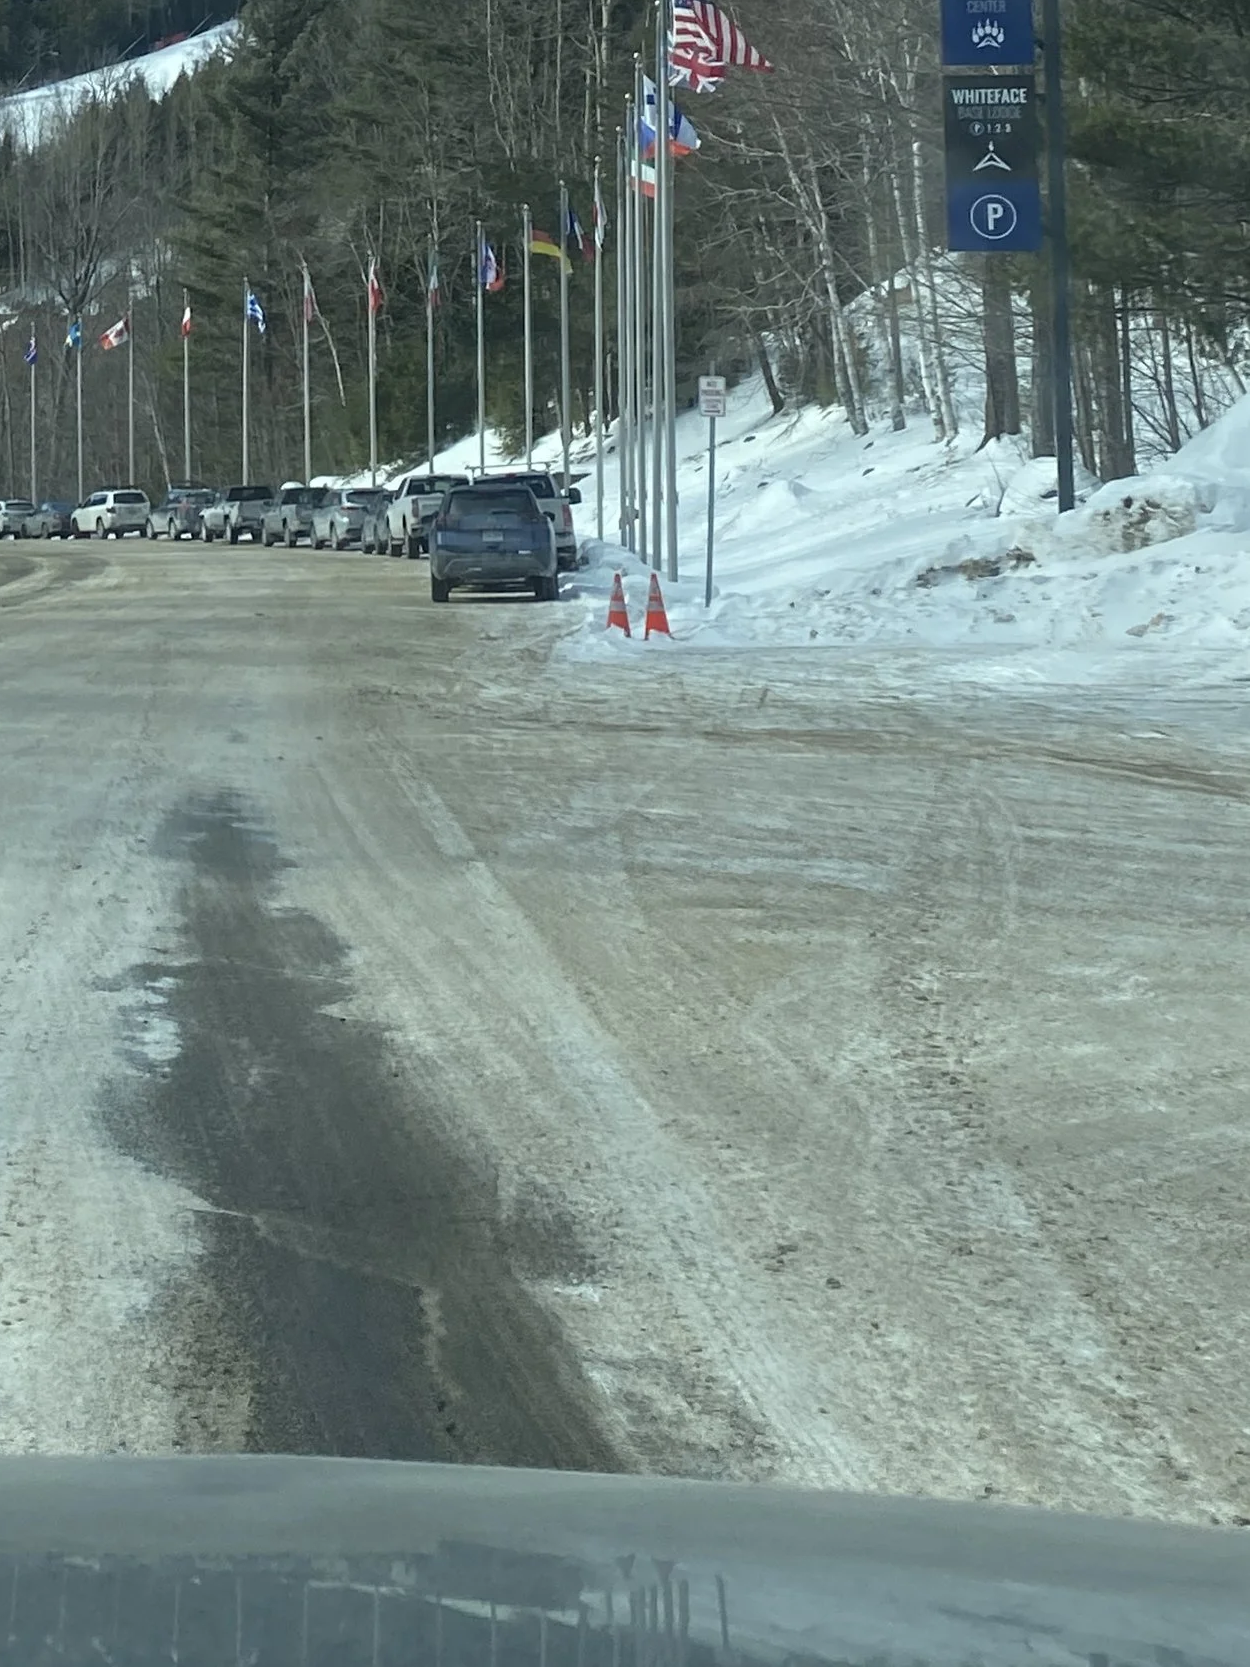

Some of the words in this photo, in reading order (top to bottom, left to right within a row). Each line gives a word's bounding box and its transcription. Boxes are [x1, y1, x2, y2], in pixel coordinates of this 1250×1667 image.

[966, 0, 1007, 14] CENTER
[951, 88, 1028, 104] WHITEFACE
[988, 203, 1003, 230] P
